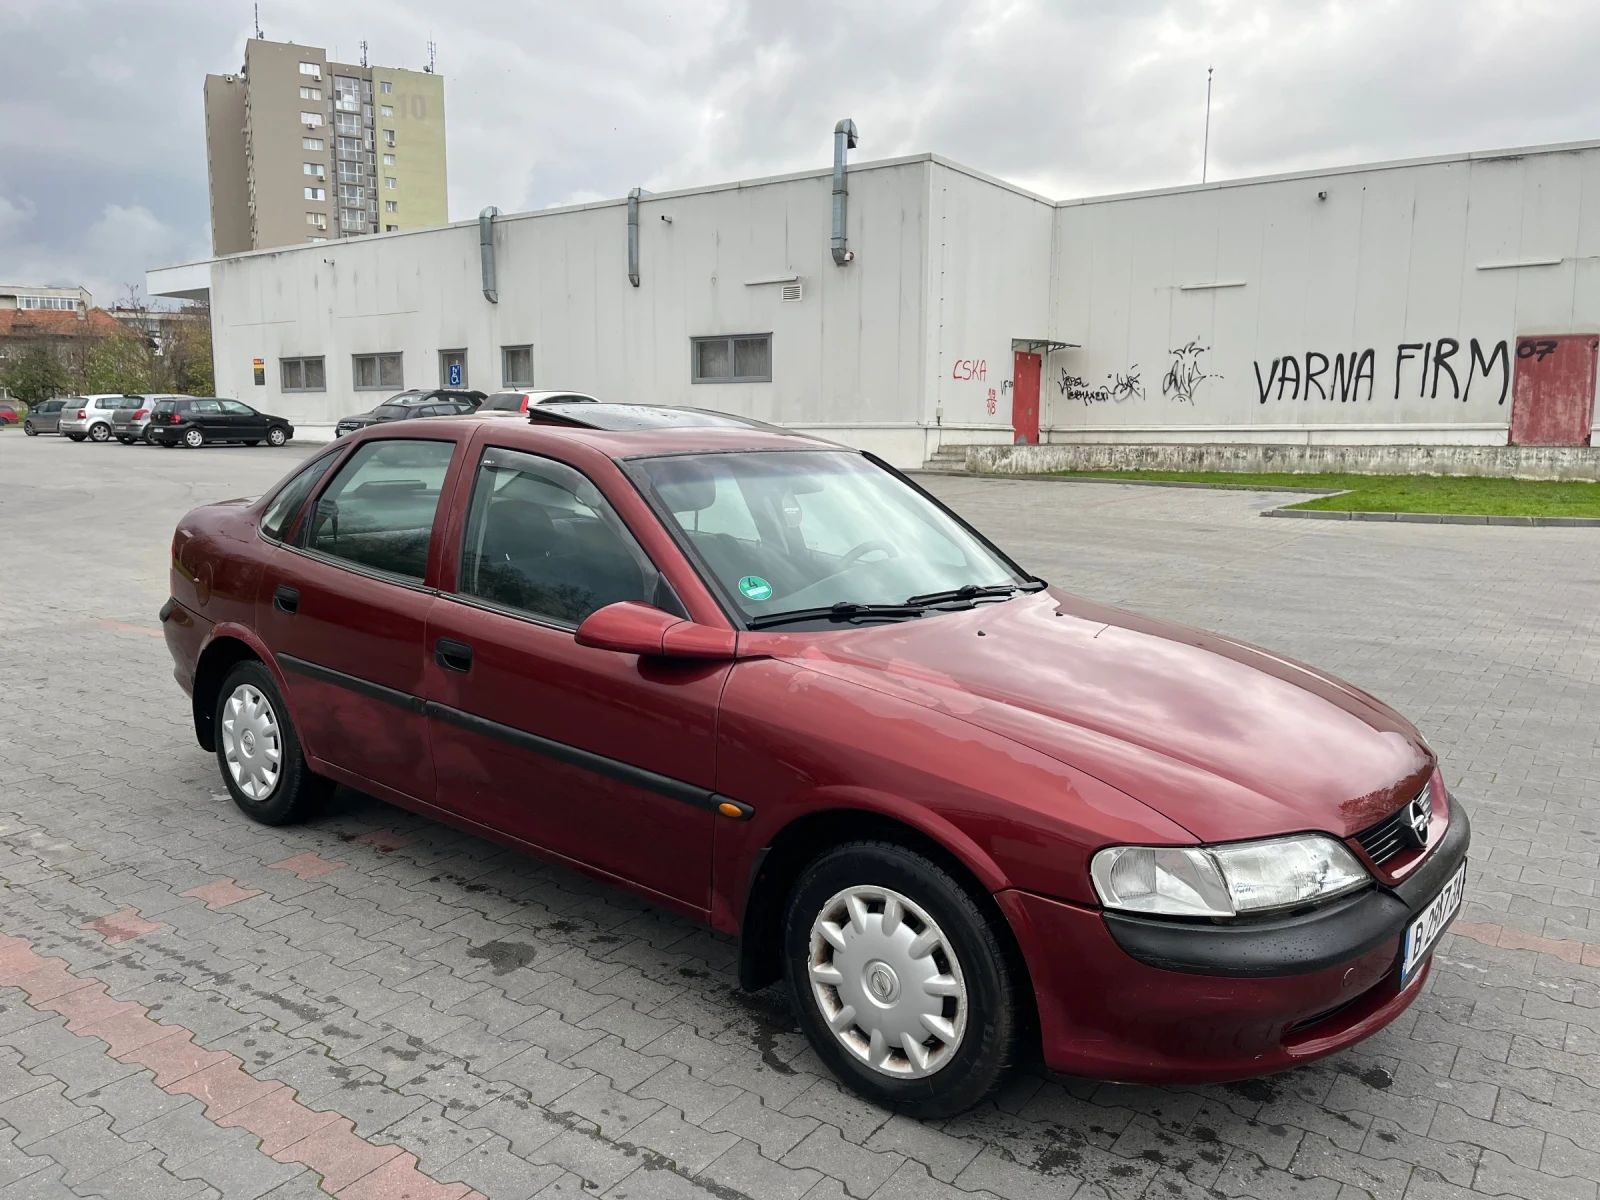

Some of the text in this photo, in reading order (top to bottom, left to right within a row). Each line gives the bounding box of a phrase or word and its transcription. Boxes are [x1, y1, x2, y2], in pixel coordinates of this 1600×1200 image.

[953, 359, 987, 382] CSKA
[1253, 348, 1375, 404] VARNA
[1394, 338, 1510, 405] FIRM
[1517, 340, 1558, 362] 07
[747, 577, 759, 588] 4
